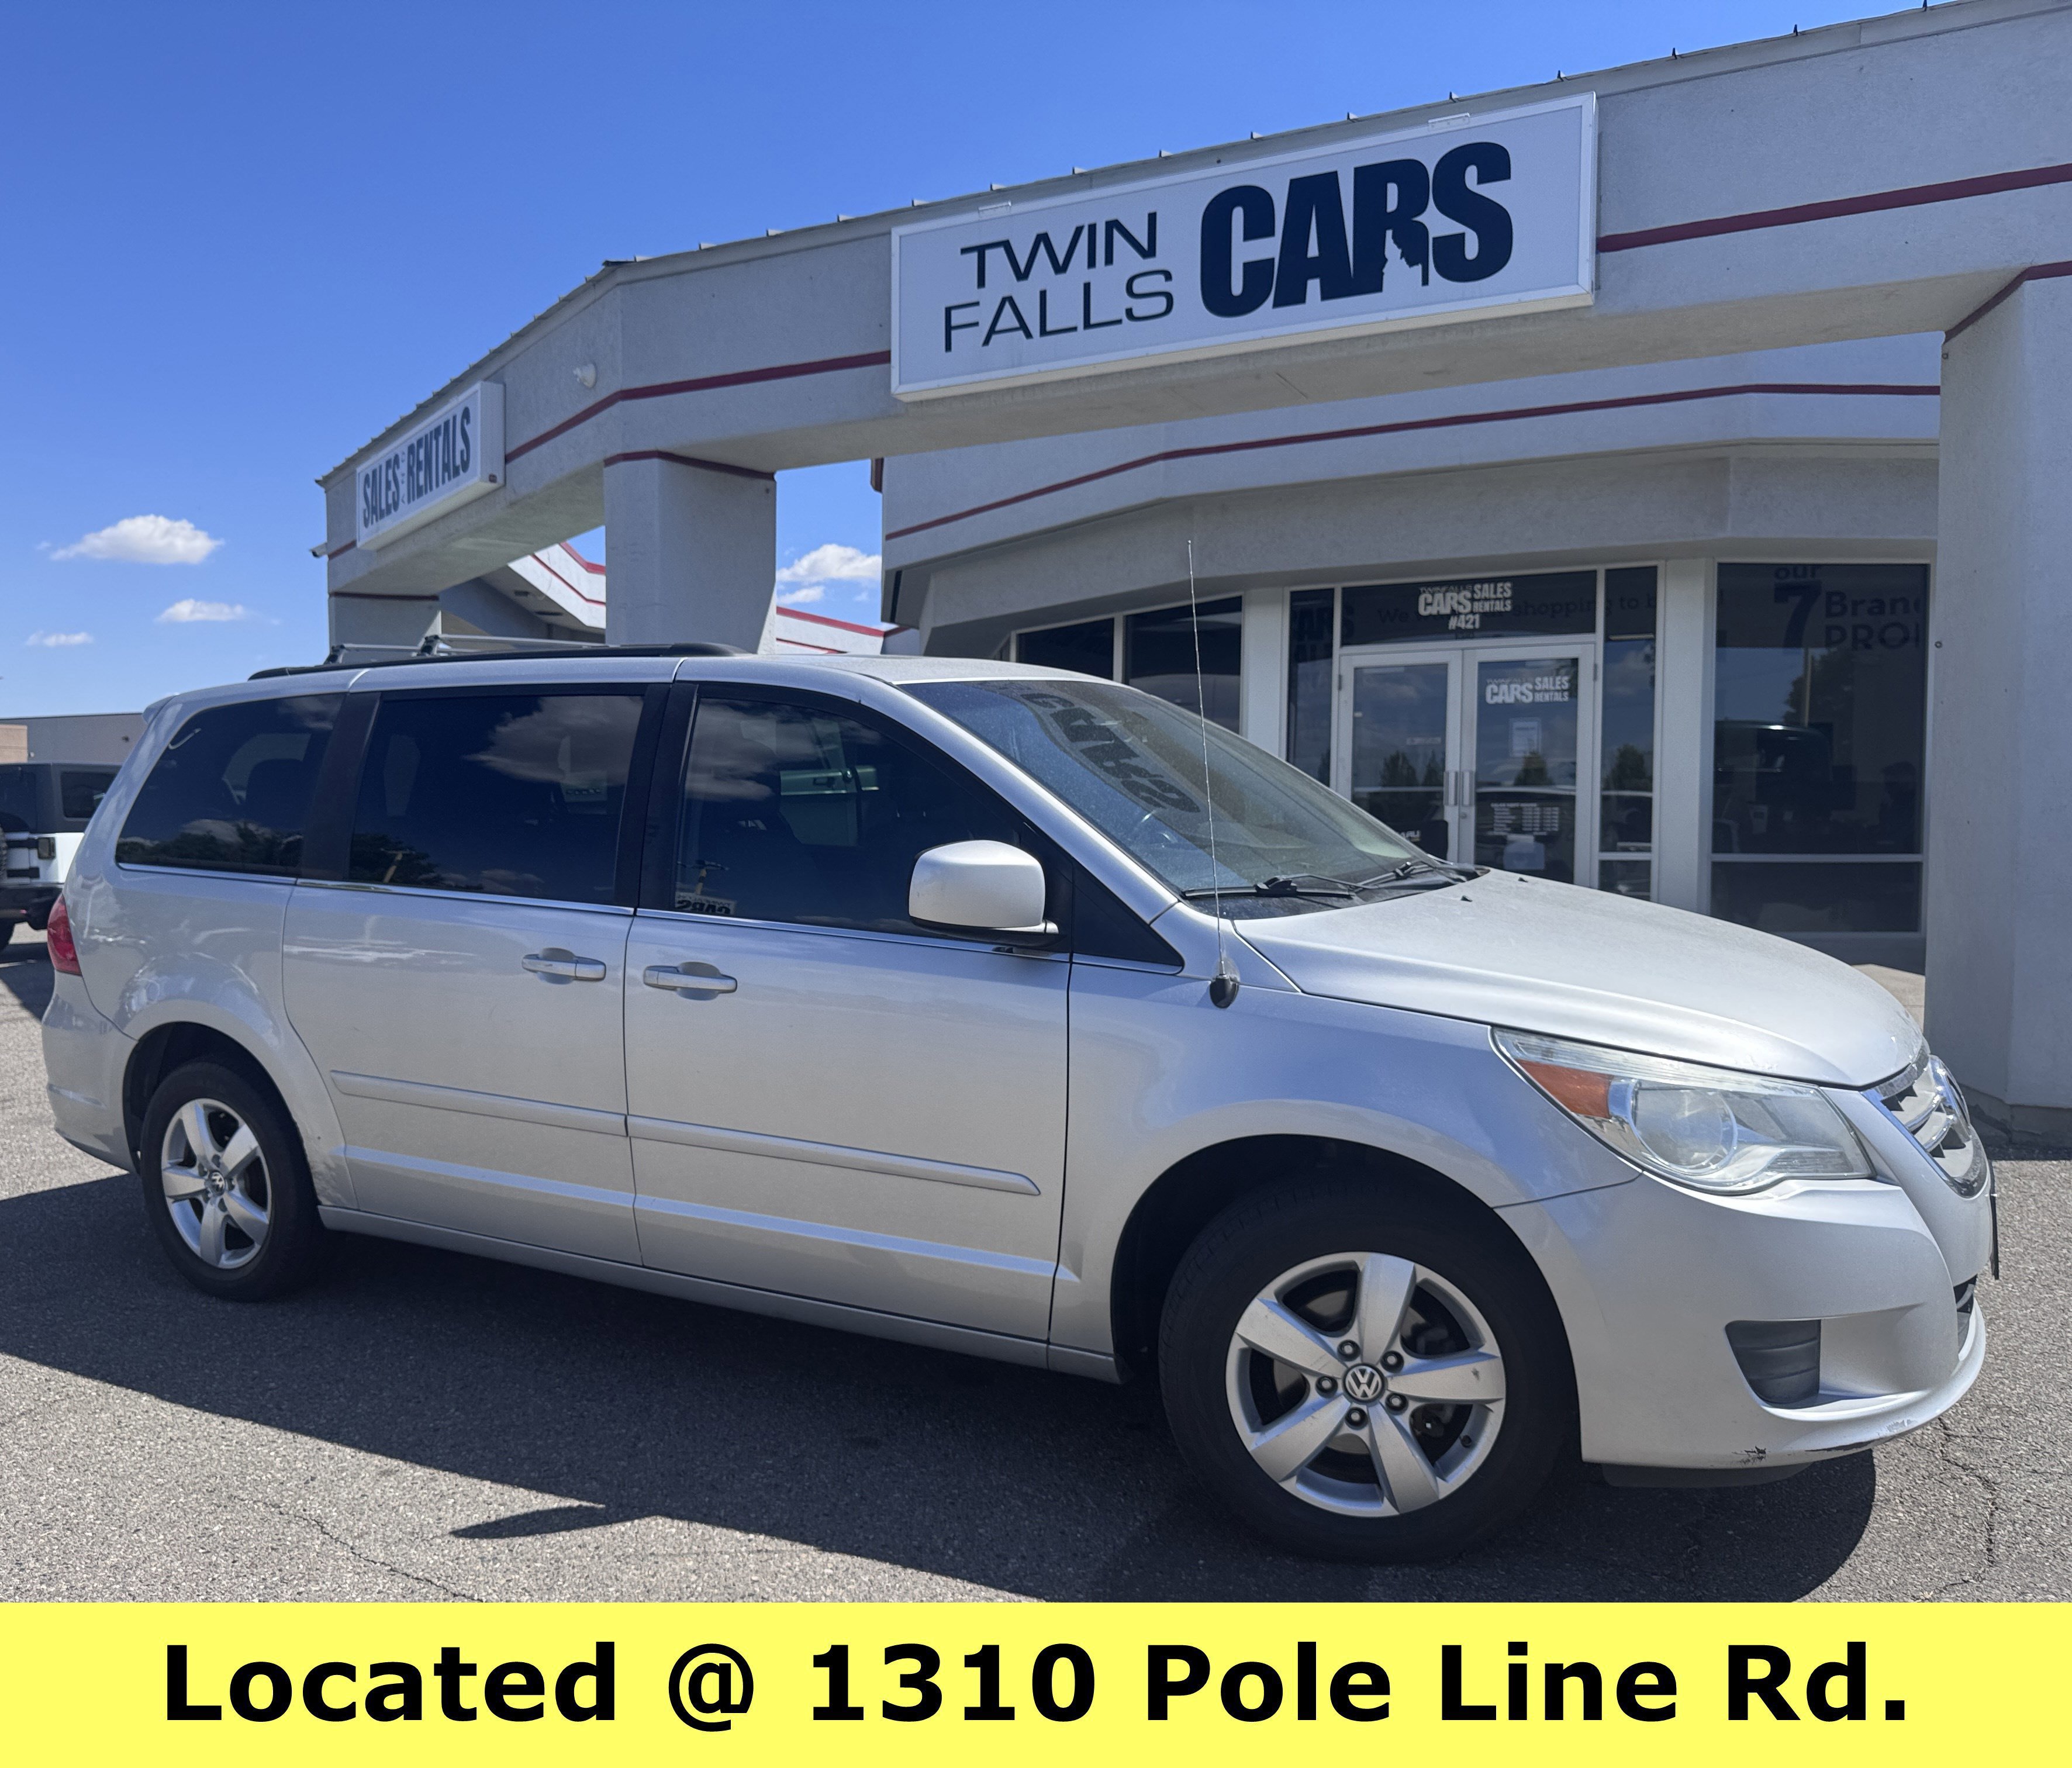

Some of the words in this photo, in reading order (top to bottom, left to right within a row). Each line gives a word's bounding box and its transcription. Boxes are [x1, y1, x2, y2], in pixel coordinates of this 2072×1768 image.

[1200, 141, 1513, 317] CARS
[961, 212, 1157, 289] TWIN
[944, 269, 1174, 353] FALLS
[407, 406, 471, 505] RENTALS
[362, 454, 400, 529] SALES
[1473, 581, 1512, 599] SALES
[1418, 591, 1472, 616] CARS
[1473, 599, 1512, 613] RENTALS
[1448, 613, 1480, 630] #421
[1486, 682, 1534, 705] CARS
[1534, 675, 1570, 690] SALES
[1534, 691, 1569, 702] RENTALS
